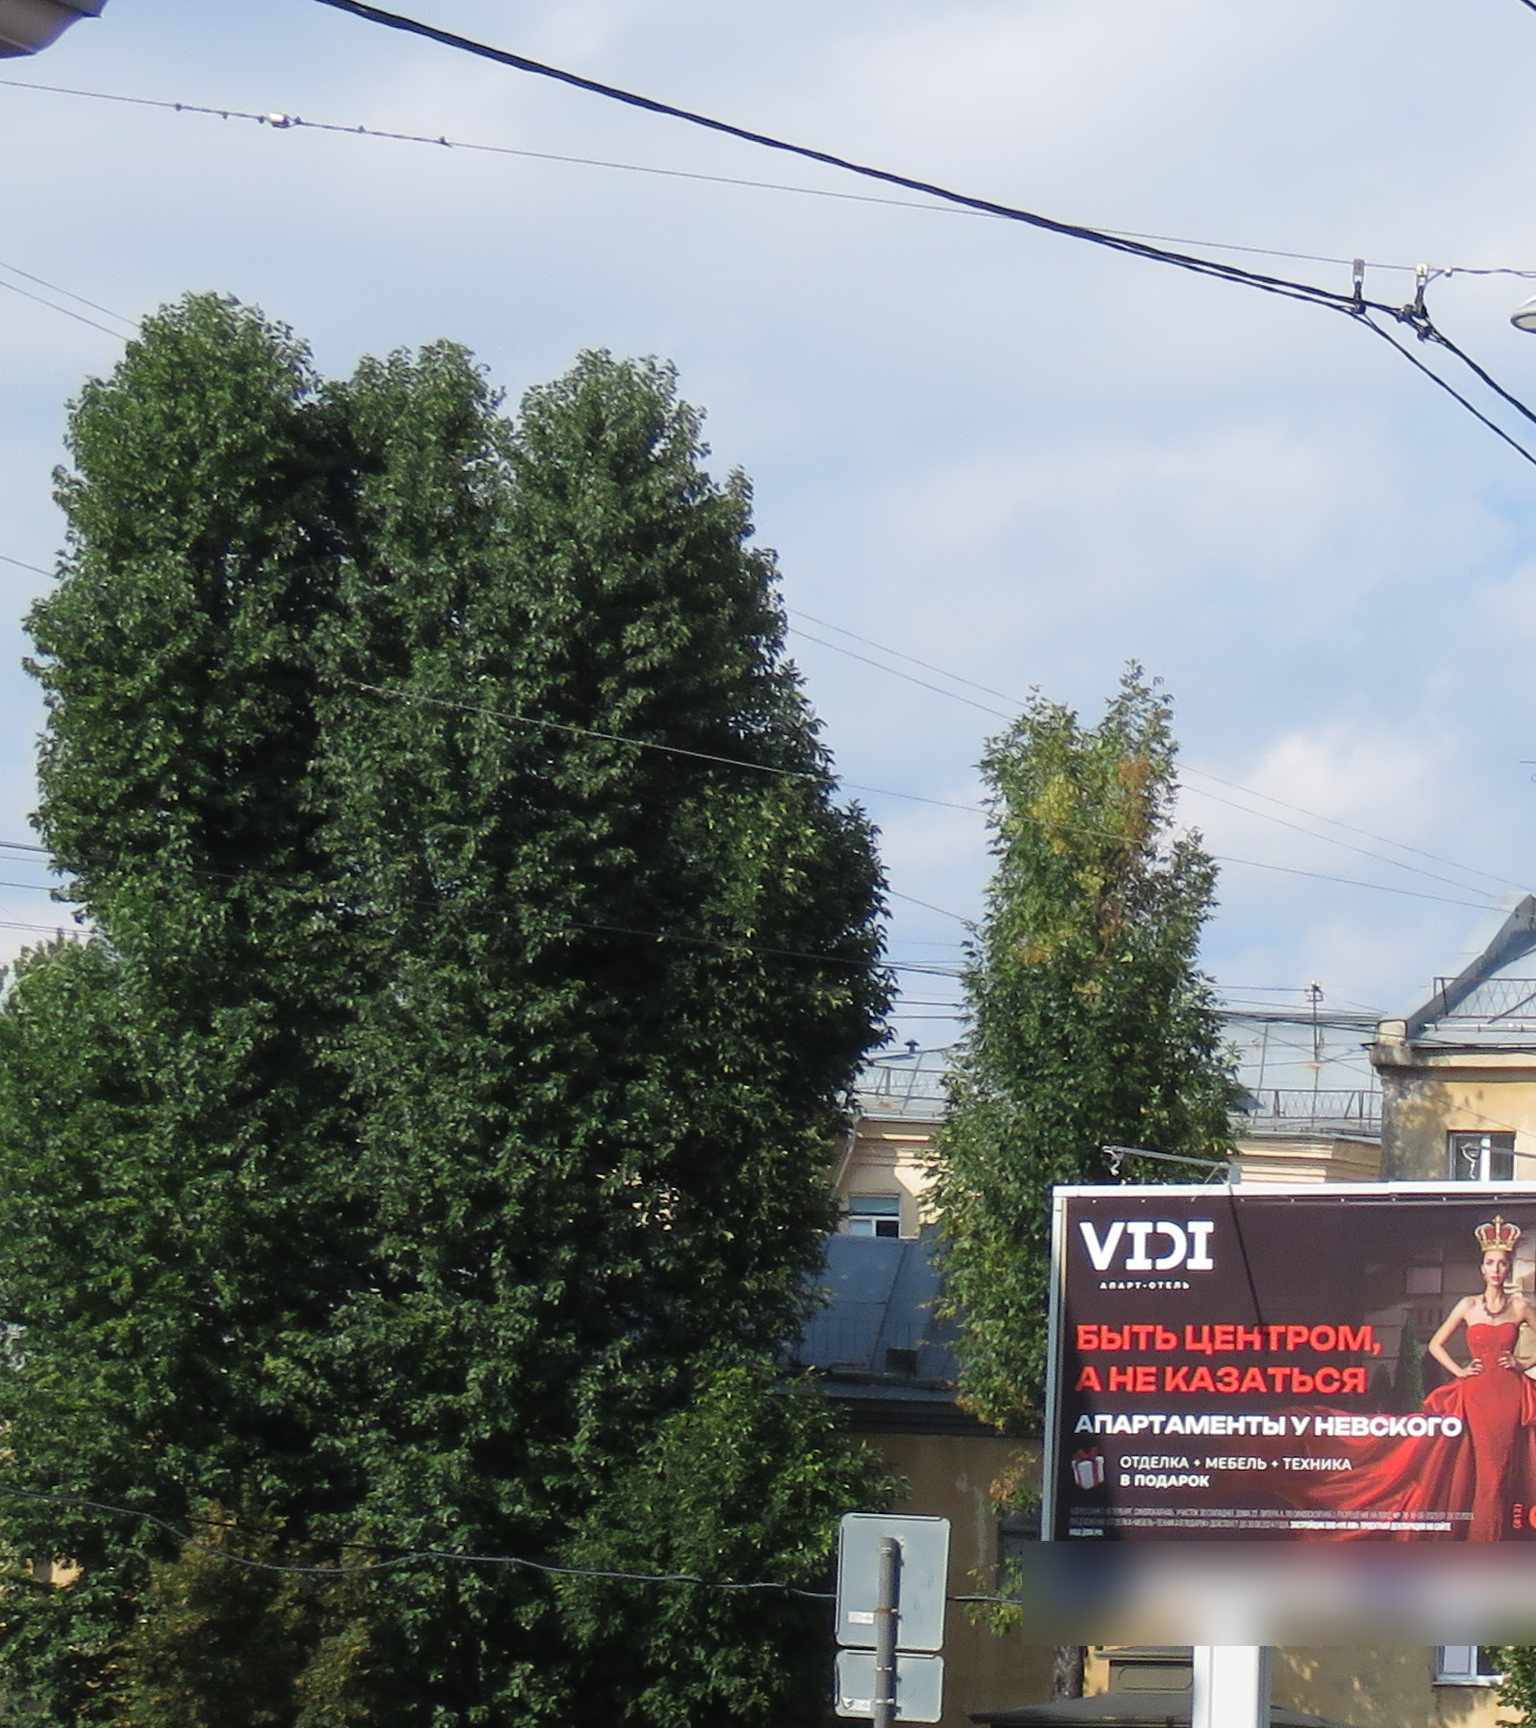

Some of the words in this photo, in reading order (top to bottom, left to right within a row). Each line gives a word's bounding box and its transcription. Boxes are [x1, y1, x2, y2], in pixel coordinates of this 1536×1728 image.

[1079, 1221, 1214, 1270] VIDI
[1099, 1280, 1191, 1290] АПАРТ-ОТЕЛЬ
[1077, 1324, 1178, 1351] БЫТЬ
[1184, 1324, 1383, 1355] ЦЕНТРОМ,
[1076, 1366, 1101, 1392] А
[1108, 1366, 1157, 1393] НЕ
[1164, 1366, 1367, 1394] КАЗАТЬСЯ
[1074, 1415, 1285, 1437] АПАРТАМЕНТЫ
[1290, 1416, 1311, 1437] У
[1315, 1415, 1463, 1438] НЕВСКОГО
[1119, 1455, 1190, 1471] ОТДЕЛКА
[1205, 1457, 1267, 1471] МЕБЕЛЬ
[1283, 1457, 1352, 1471] ТЕХНИКА
[1119, 1474, 1130, 1487] В
[1134, 1474, 1210, 1489] ПОДАРОК
